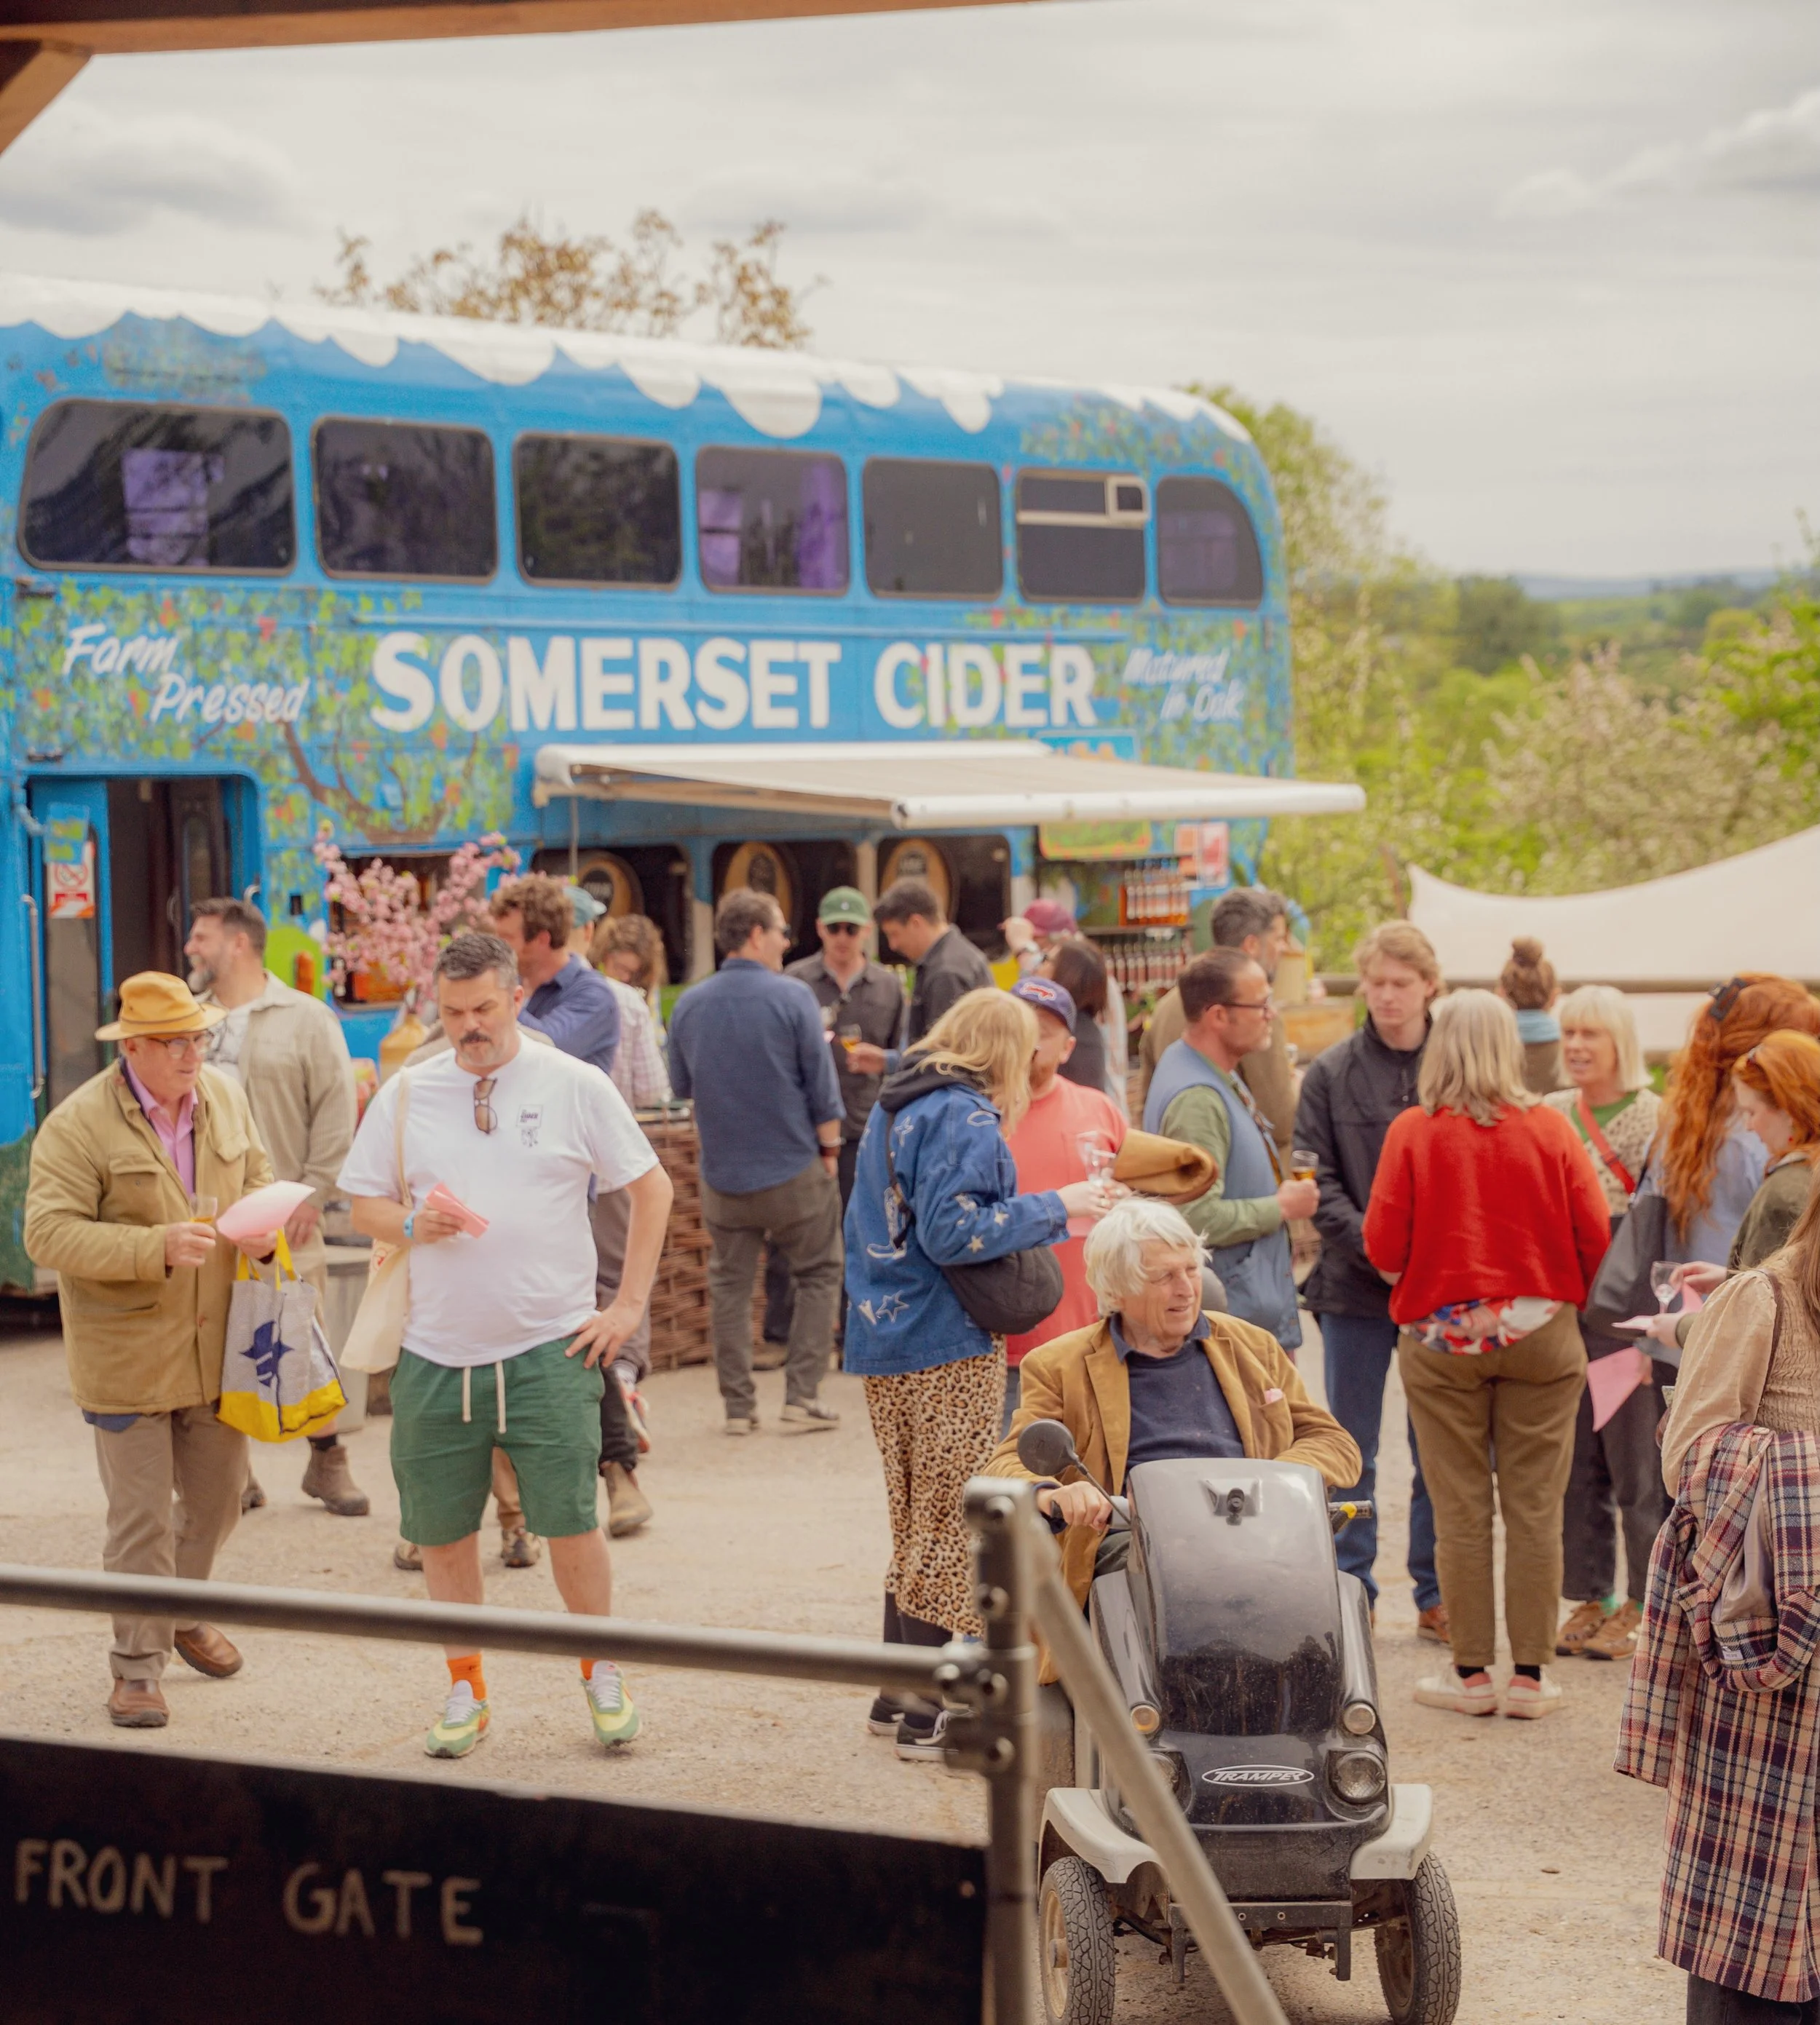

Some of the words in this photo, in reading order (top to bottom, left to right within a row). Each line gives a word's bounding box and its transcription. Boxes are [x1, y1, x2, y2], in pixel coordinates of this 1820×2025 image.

[60, 622, 180, 675] Farm
[149, 672, 310, 723] Pressed
[370, 631, 842, 732] SOMERSET
[874, 641, 1098, 729] CIDER
[1192, 677, 1245, 722] Oak
[1212, 1770, 1305, 1782] TRAMPER
[15, 1838, 230, 1924] FRONT
[282, 1862, 484, 1946] GATE
